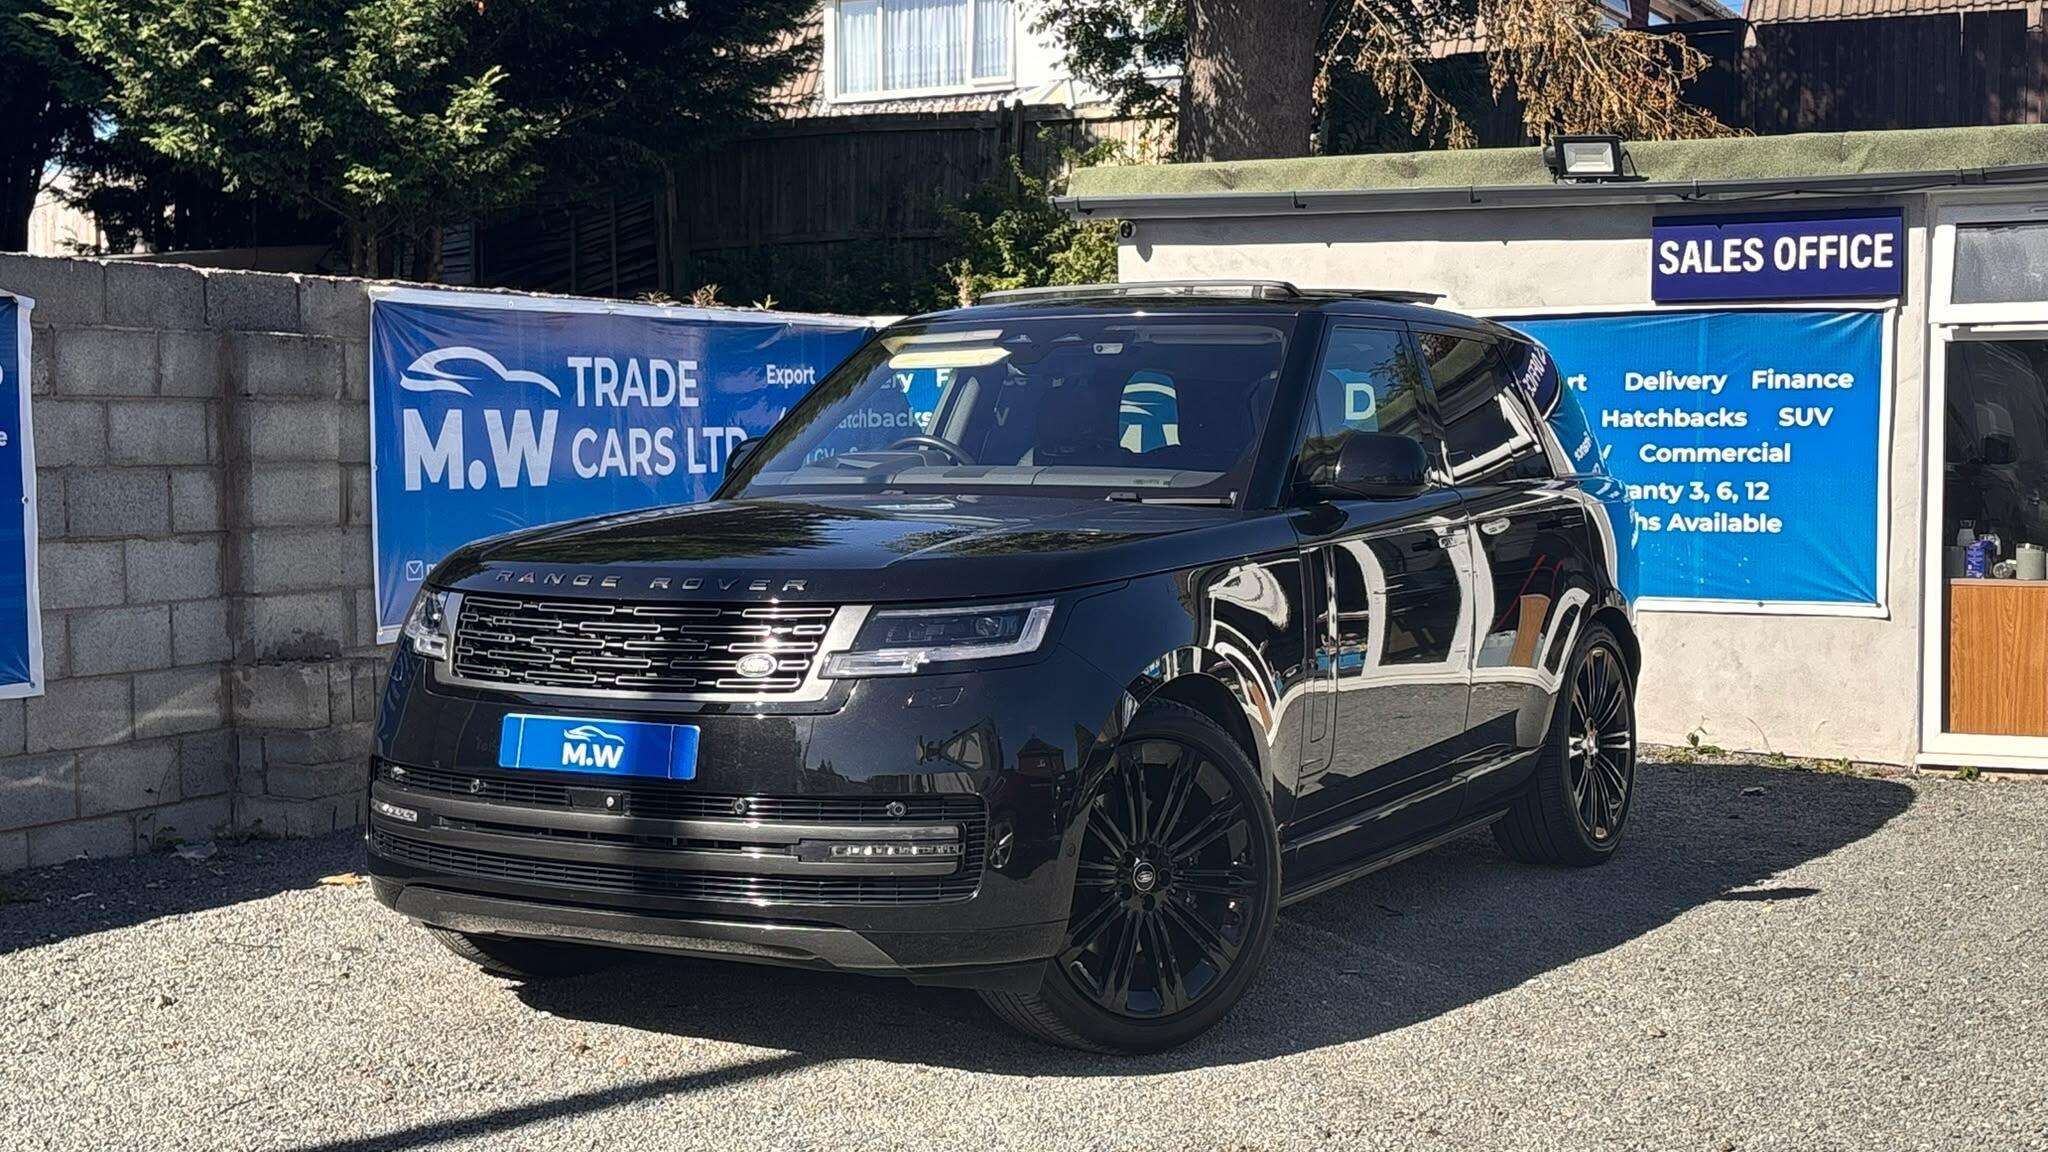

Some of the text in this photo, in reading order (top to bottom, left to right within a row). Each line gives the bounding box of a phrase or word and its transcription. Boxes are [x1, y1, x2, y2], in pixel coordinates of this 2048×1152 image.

[1659, 233, 1894, 275] SALES OFFICE
[567, 356, 699, 407] TRADE
[766, 364, 816, 389] Export
[1625, 371, 1727, 395] Delivery
[1752, 368, 1854, 390] Finance
[1601, 407, 1834, 428] Hatchbacks SUV
[403, 408, 559, 492] M.W
[571, 426, 677, 479] CARS
[1639, 441, 1791, 463] Commercial
[1689, 481, 1710, 503] 3,
[1716, 481, 1739, 503] 6,
[1745, 481, 1770, 501] 12
[1666, 512, 1783, 533] Available
[495, 570, 808, 592] RANGE ROVER
[562, 742, 624, 769] M.W
